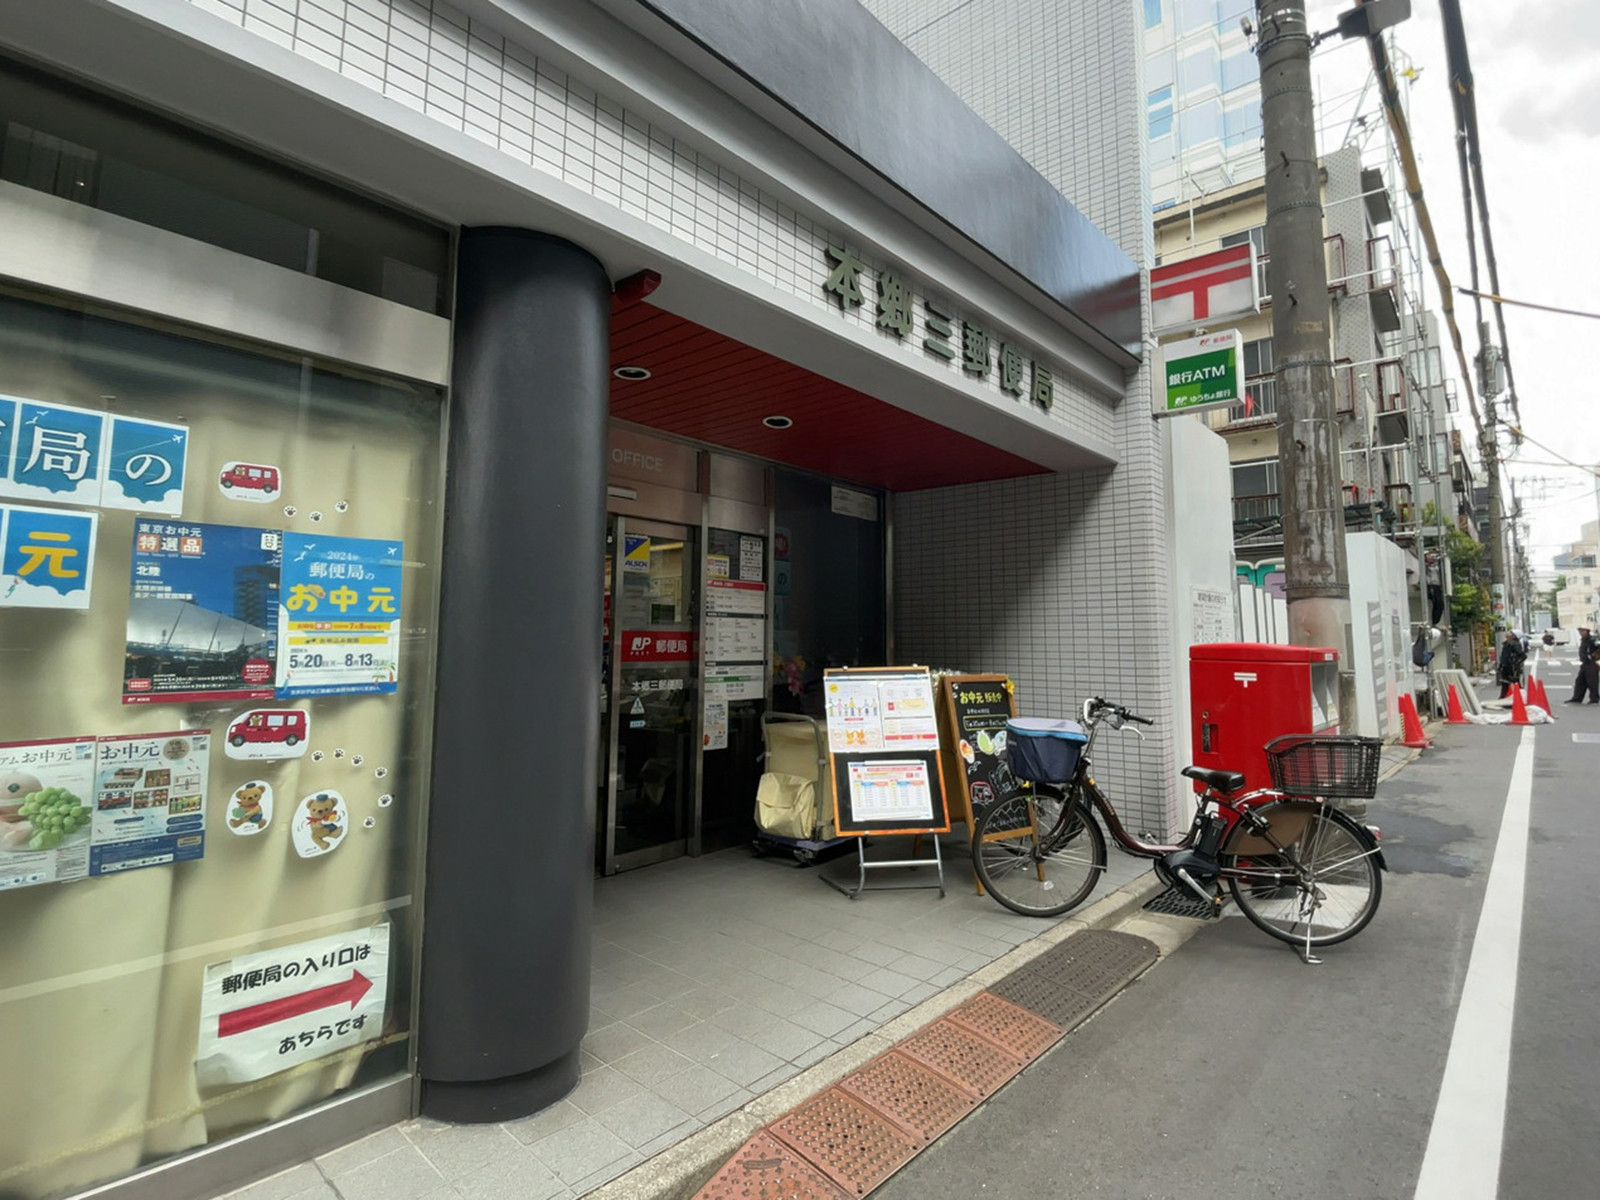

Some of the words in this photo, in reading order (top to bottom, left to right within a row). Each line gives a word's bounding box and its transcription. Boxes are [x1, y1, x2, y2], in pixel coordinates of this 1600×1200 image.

[823, 244, 1054, 410] 本郷三郵便局
[1168, 364, 1226, 387] 銀行ATM
[1190, 389, 1232, 403] ゆうちょ銀行
[0, 422, 173, 487] 局の
[611, 448, 665, 472] OFFICE
[138, 523, 202, 538] 東京お中元
[17, 531, 80, 578] 元
[138, 536, 201, 553] 特選品
[309, 562, 376, 581] 郵便局の
[286, 584, 397, 613] お中元
[655, 639, 688, 654] 郵便局
[100, 741, 160, 761] お中元
[221, 944, 371, 995] 郵便局の入り口は
[278, 1014, 368, 1055] あちらです
